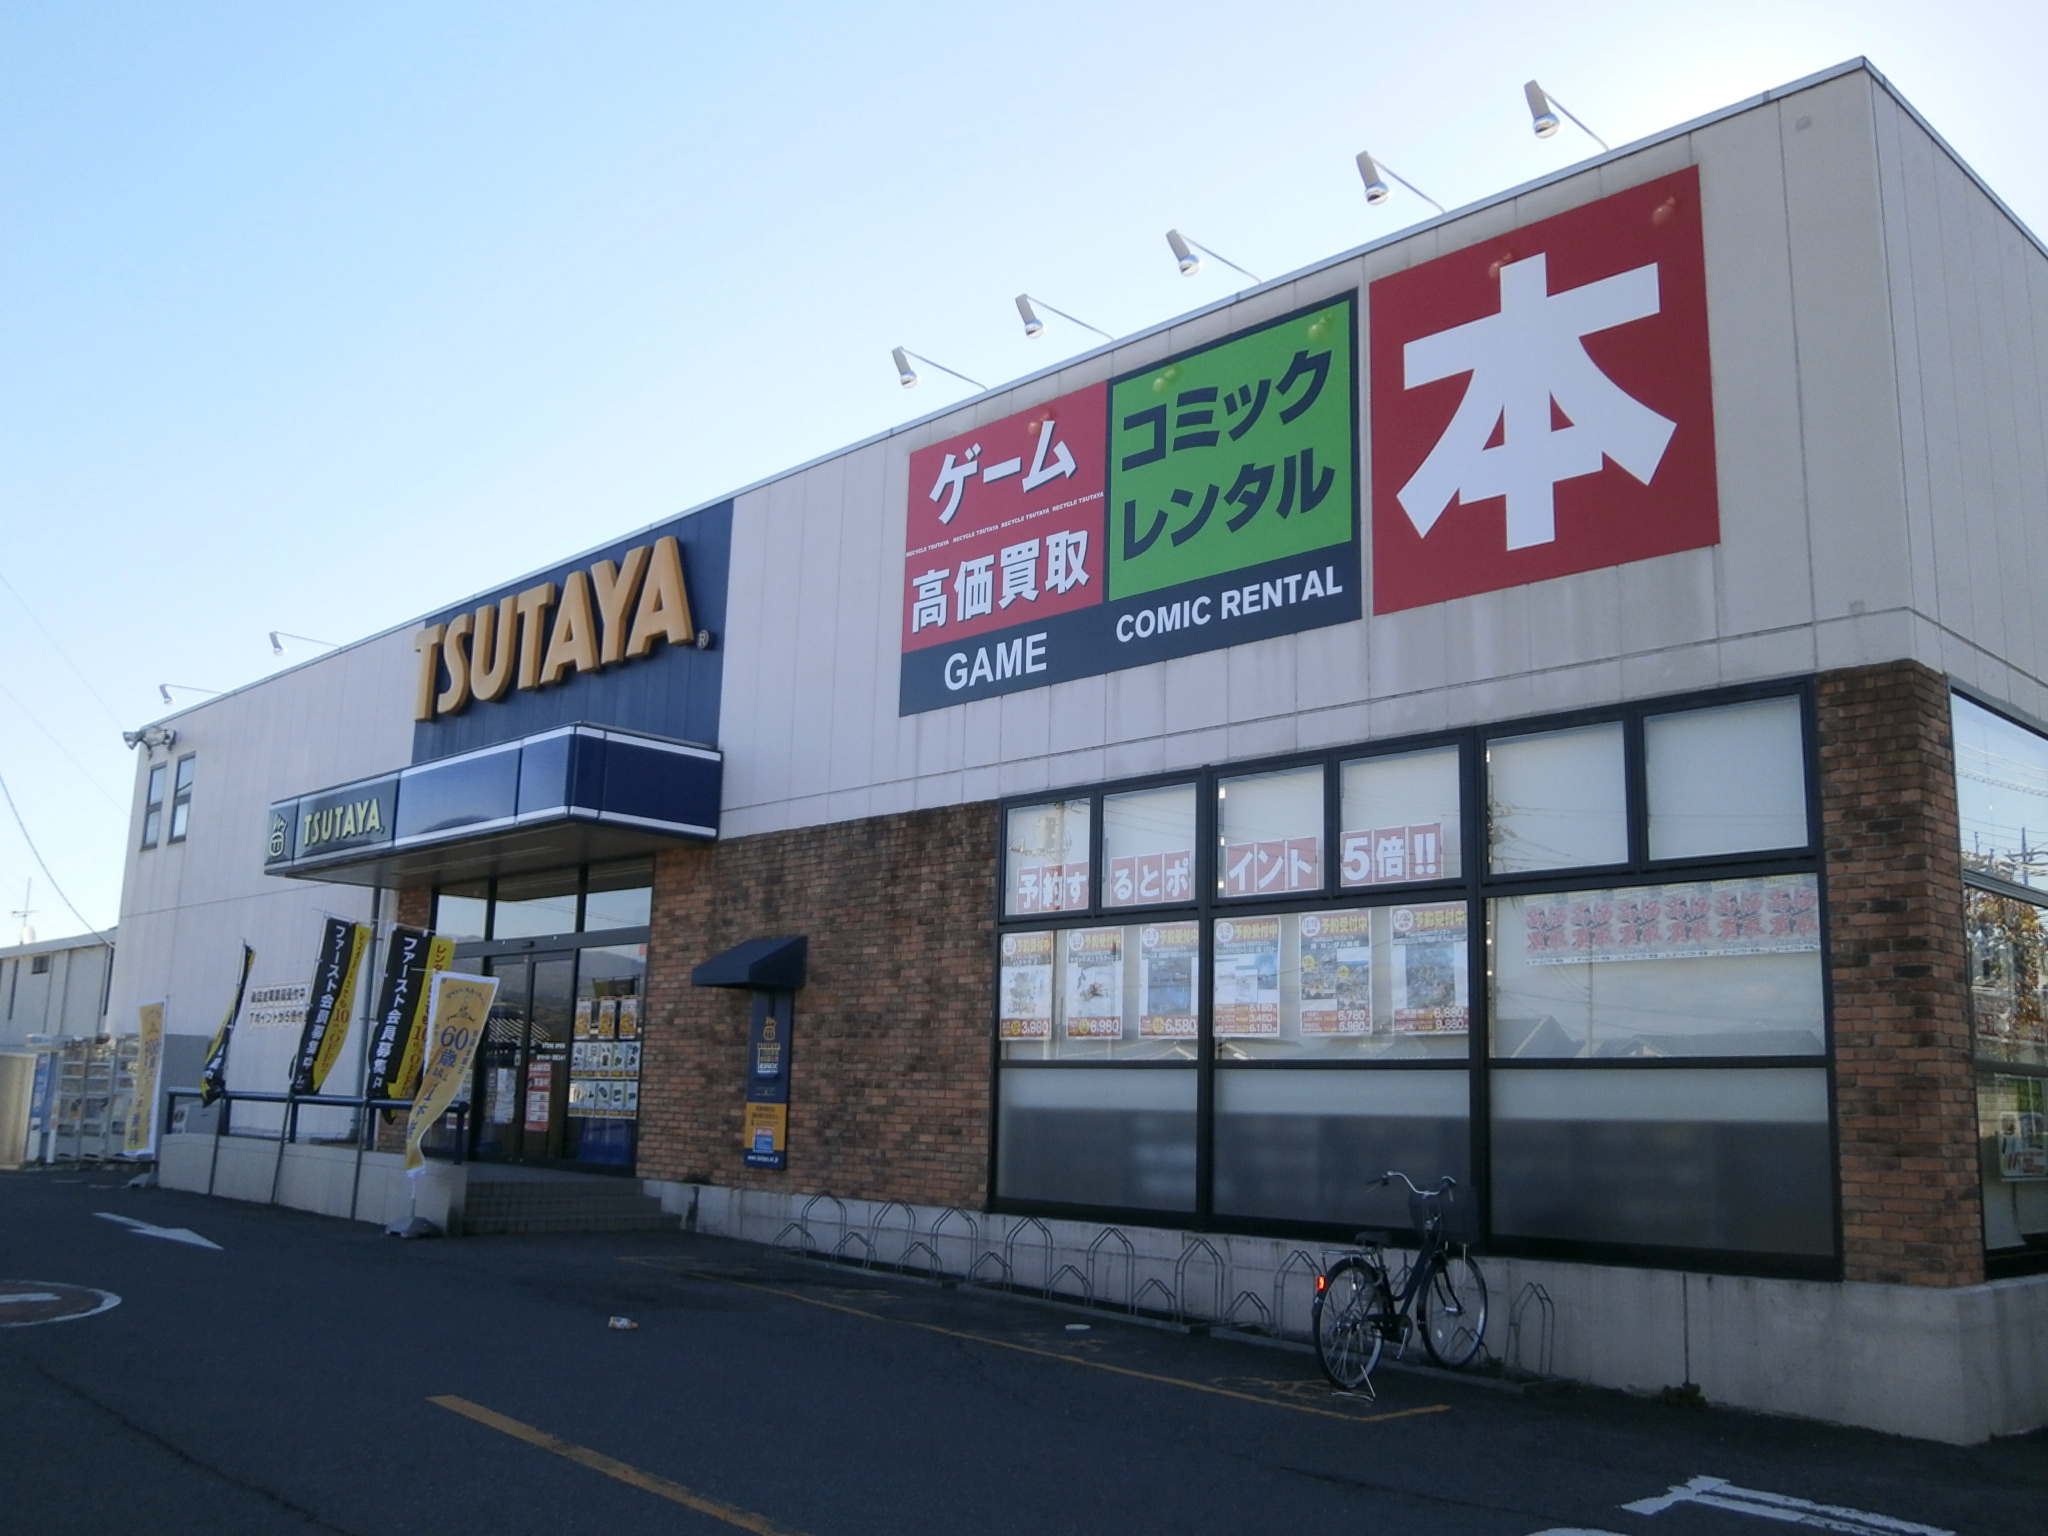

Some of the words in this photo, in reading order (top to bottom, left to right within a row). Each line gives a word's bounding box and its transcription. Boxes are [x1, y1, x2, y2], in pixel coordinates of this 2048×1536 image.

[1121, 349, 1331, 472] コミック
[1397, 252, 1677, 551] 本
[906, 546, 927, 557] RECYCLE
[928, 540, 949, 551] TSUTAYA
[953, 532, 975, 543] RECYCLE
[976, 525, 999, 536] TSUTAYA
[1001, 516, 1024, 528] RECYCLE
[1025, 508, 1050, 520] TSUTAYA
[1052, 499, 1077, 512] RECYCLE
[1079, 491, 1104, 503] TSUTAYA
[929, 419, 1077, 525] ゲーム
[1123, 448, 1335, 561] レンタル
[414, 536, 695, 722] TSUTAYA
[912, 529, 1089, 634] 高価買取
[1116, 596, 1212, 643] COMIC
[1221, 566, 1343, 622] RENTAL
[943, 632, 1048, 691] GAME
[303, 798, 381, 846] TSUTAYA
[1321, 914, 1368, 935] 予約受付中
